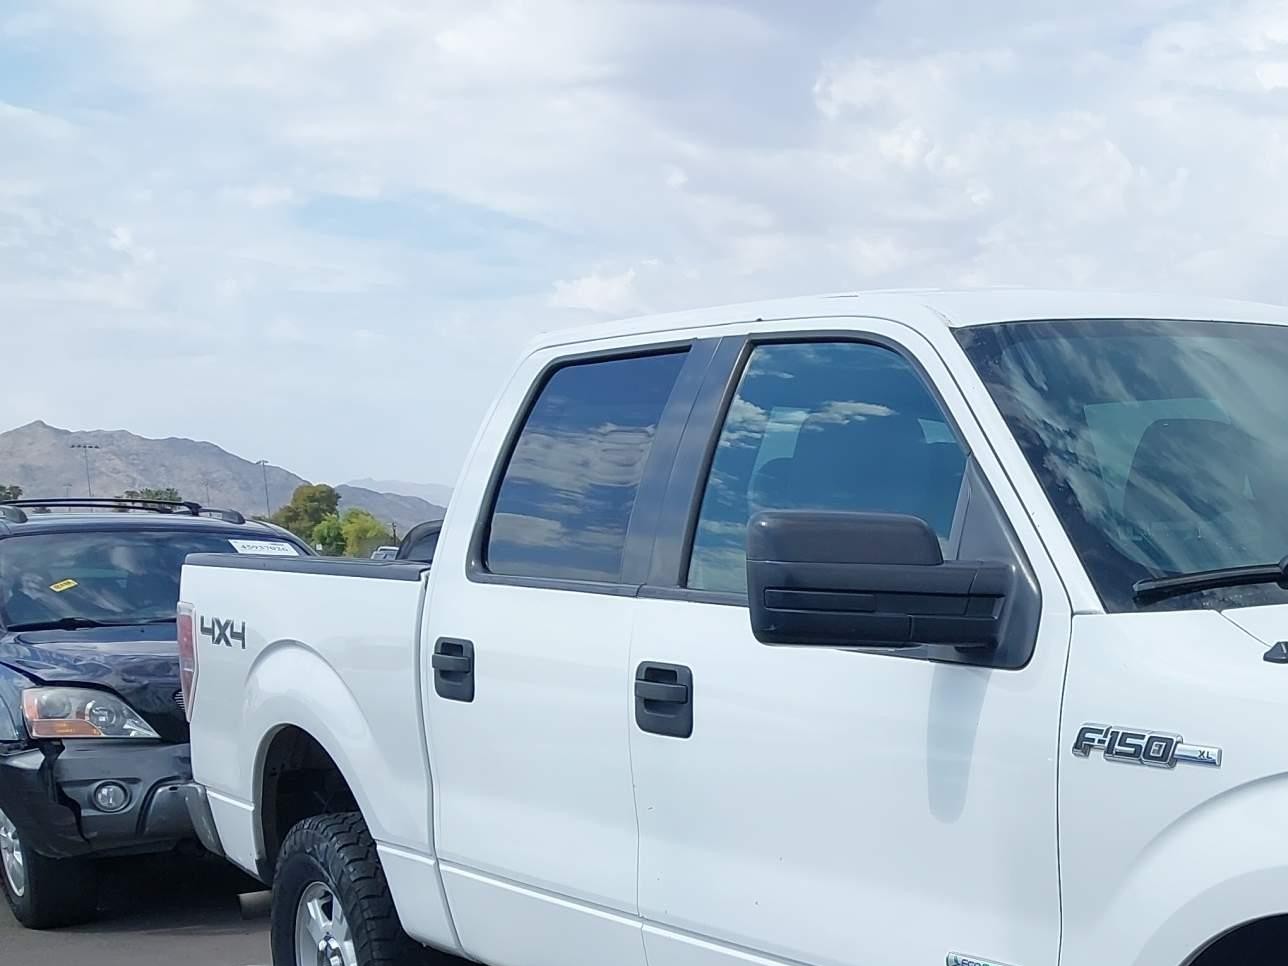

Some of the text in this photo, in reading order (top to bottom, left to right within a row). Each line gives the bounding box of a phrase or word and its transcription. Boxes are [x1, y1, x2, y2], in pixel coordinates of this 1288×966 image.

[200, 615, 246, 650] 4X4
[1072, 724, 1214, 767] F-150 XL
